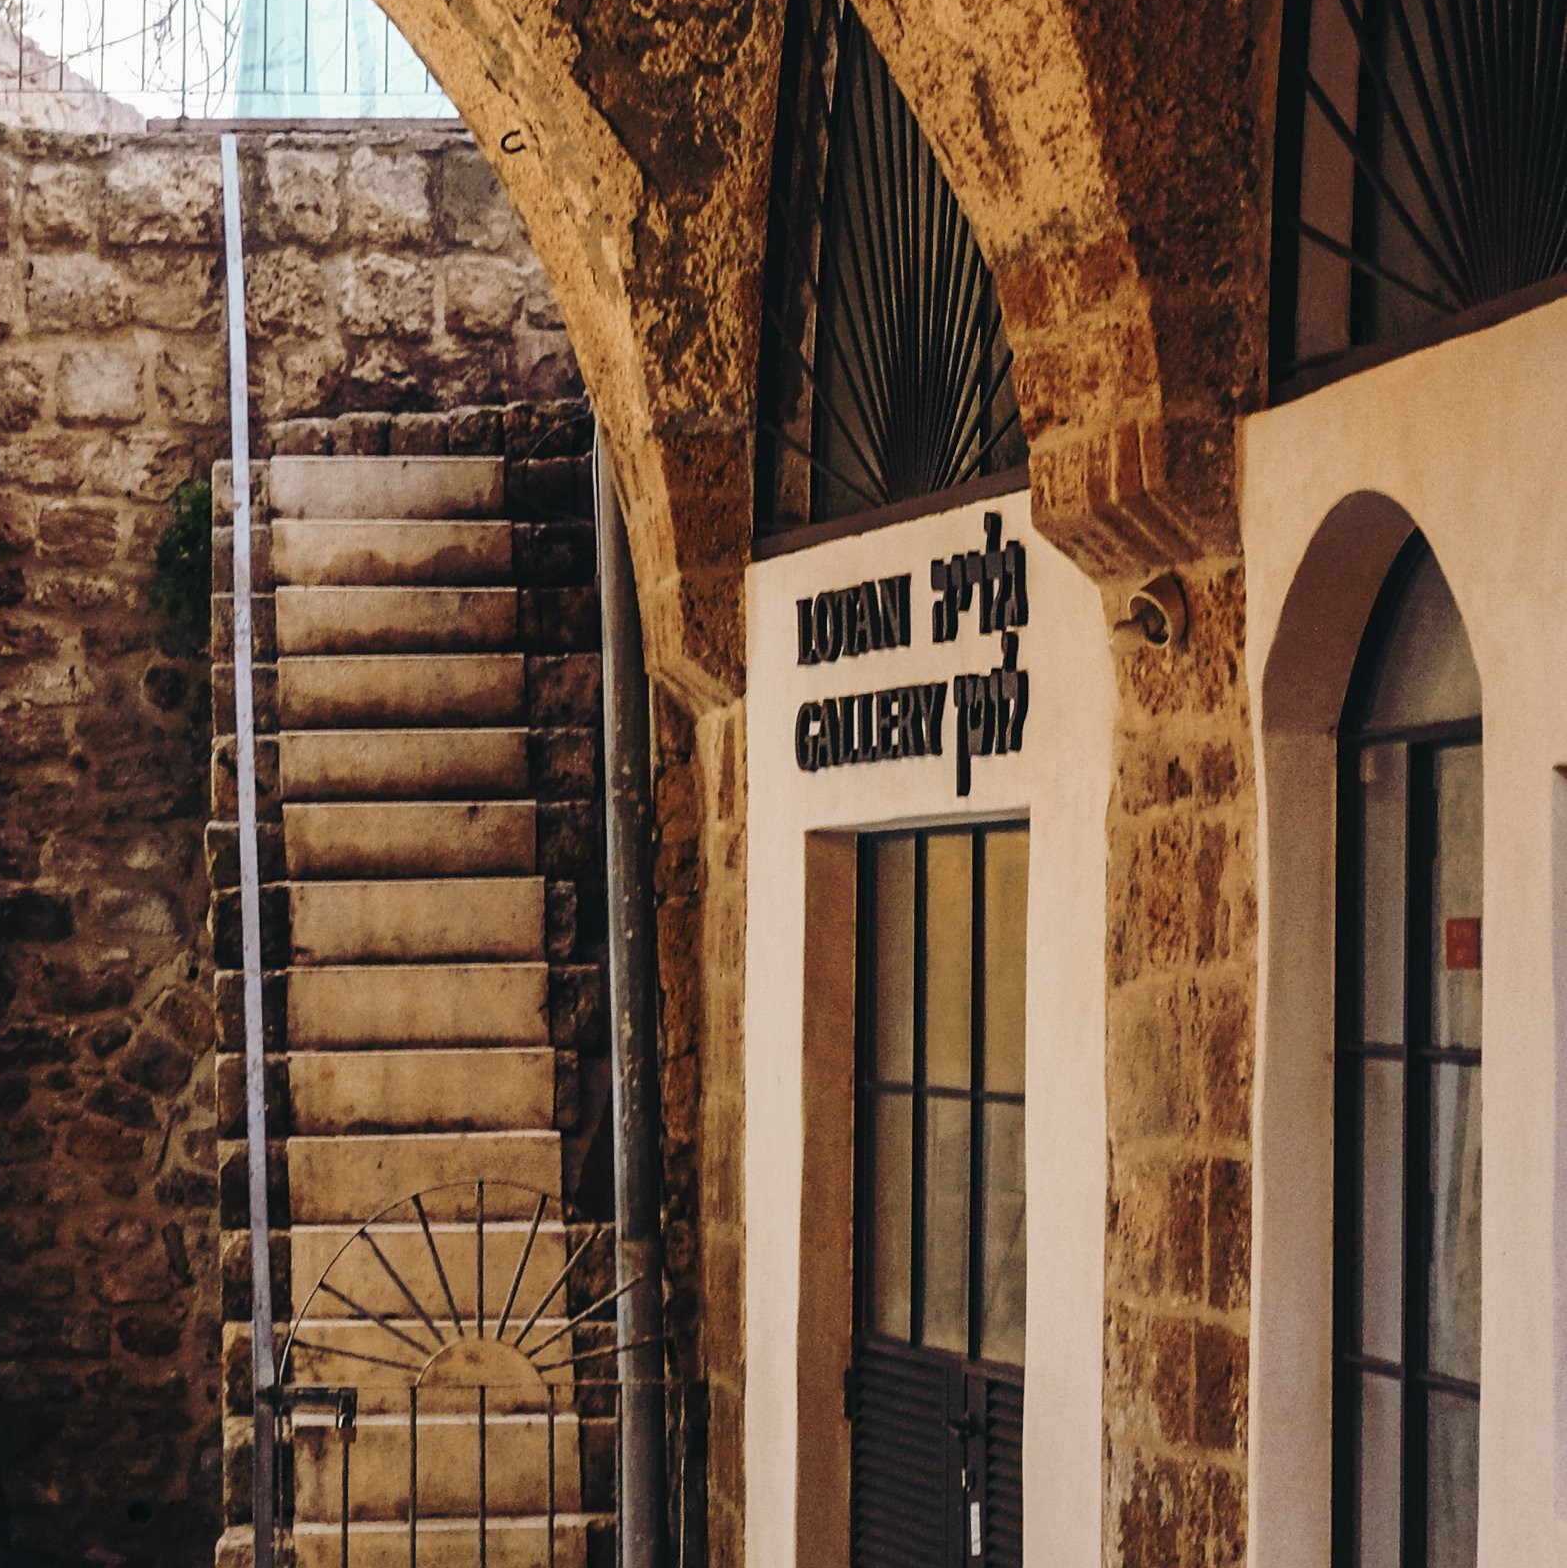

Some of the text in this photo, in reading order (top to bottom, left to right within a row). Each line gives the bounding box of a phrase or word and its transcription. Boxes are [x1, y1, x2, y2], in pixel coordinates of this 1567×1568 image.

[795, 572, 912, 665] LOTAN
[930, 512, 1029, 643] גלריה
[795, 681, 948, 773] GALLERY
[953, 630, 1029, 797] לוטן
